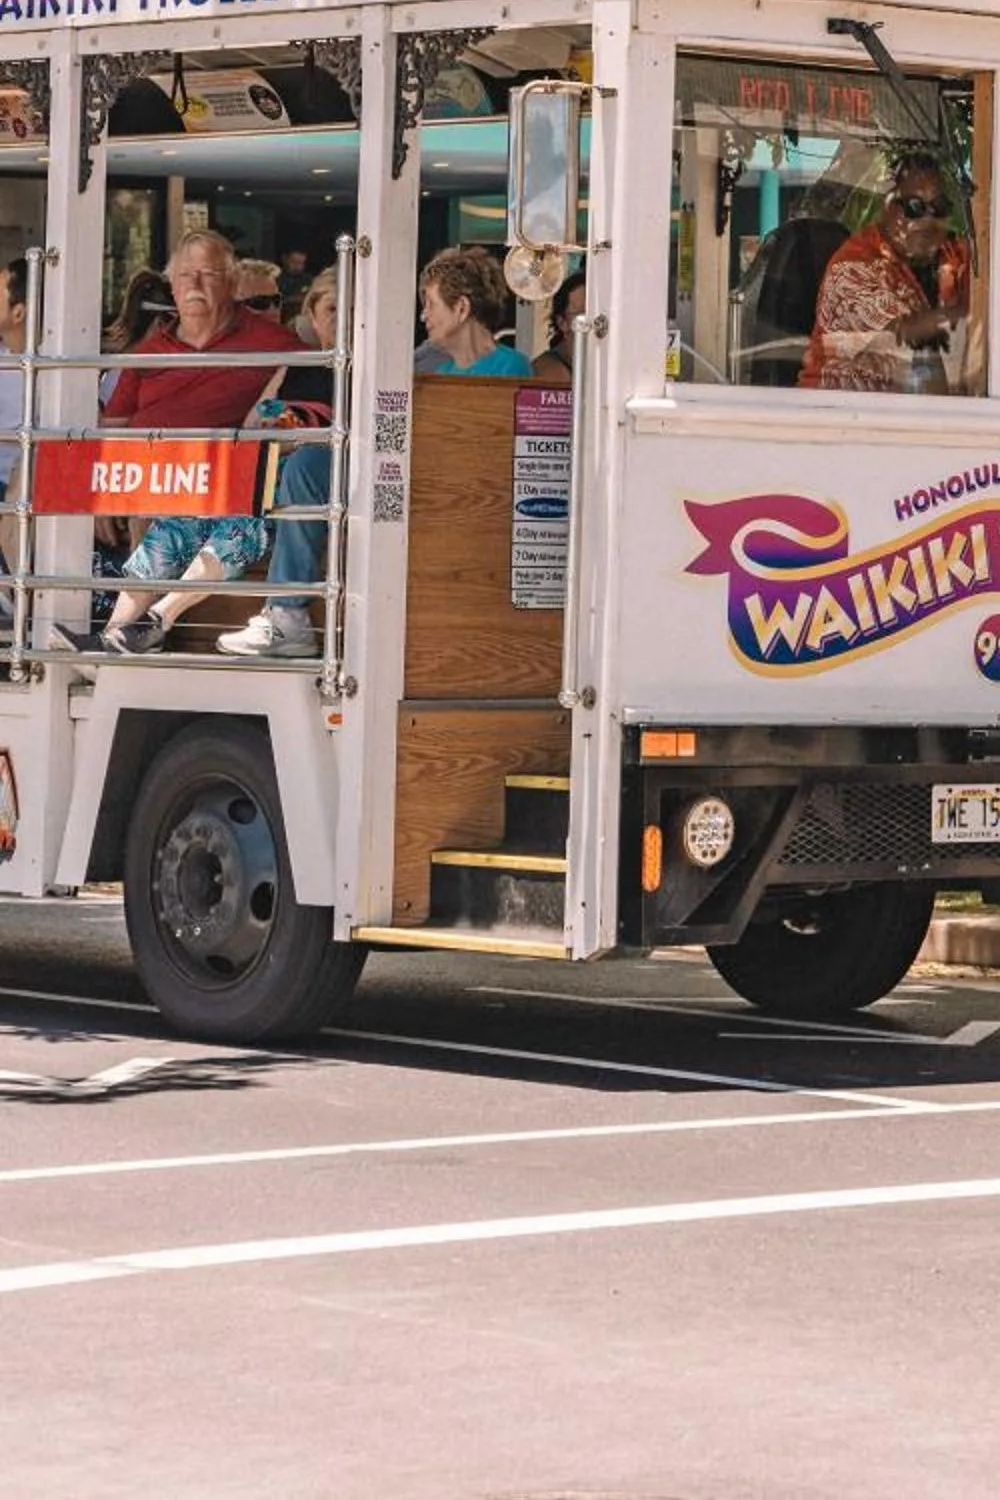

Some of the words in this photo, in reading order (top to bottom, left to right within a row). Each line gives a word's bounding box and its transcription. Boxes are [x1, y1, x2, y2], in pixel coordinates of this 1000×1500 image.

[91, 461, 143, 493] RED
[149, 462, 211, 494] LINE
[743, 522, 992, 659] WAIKIKI
